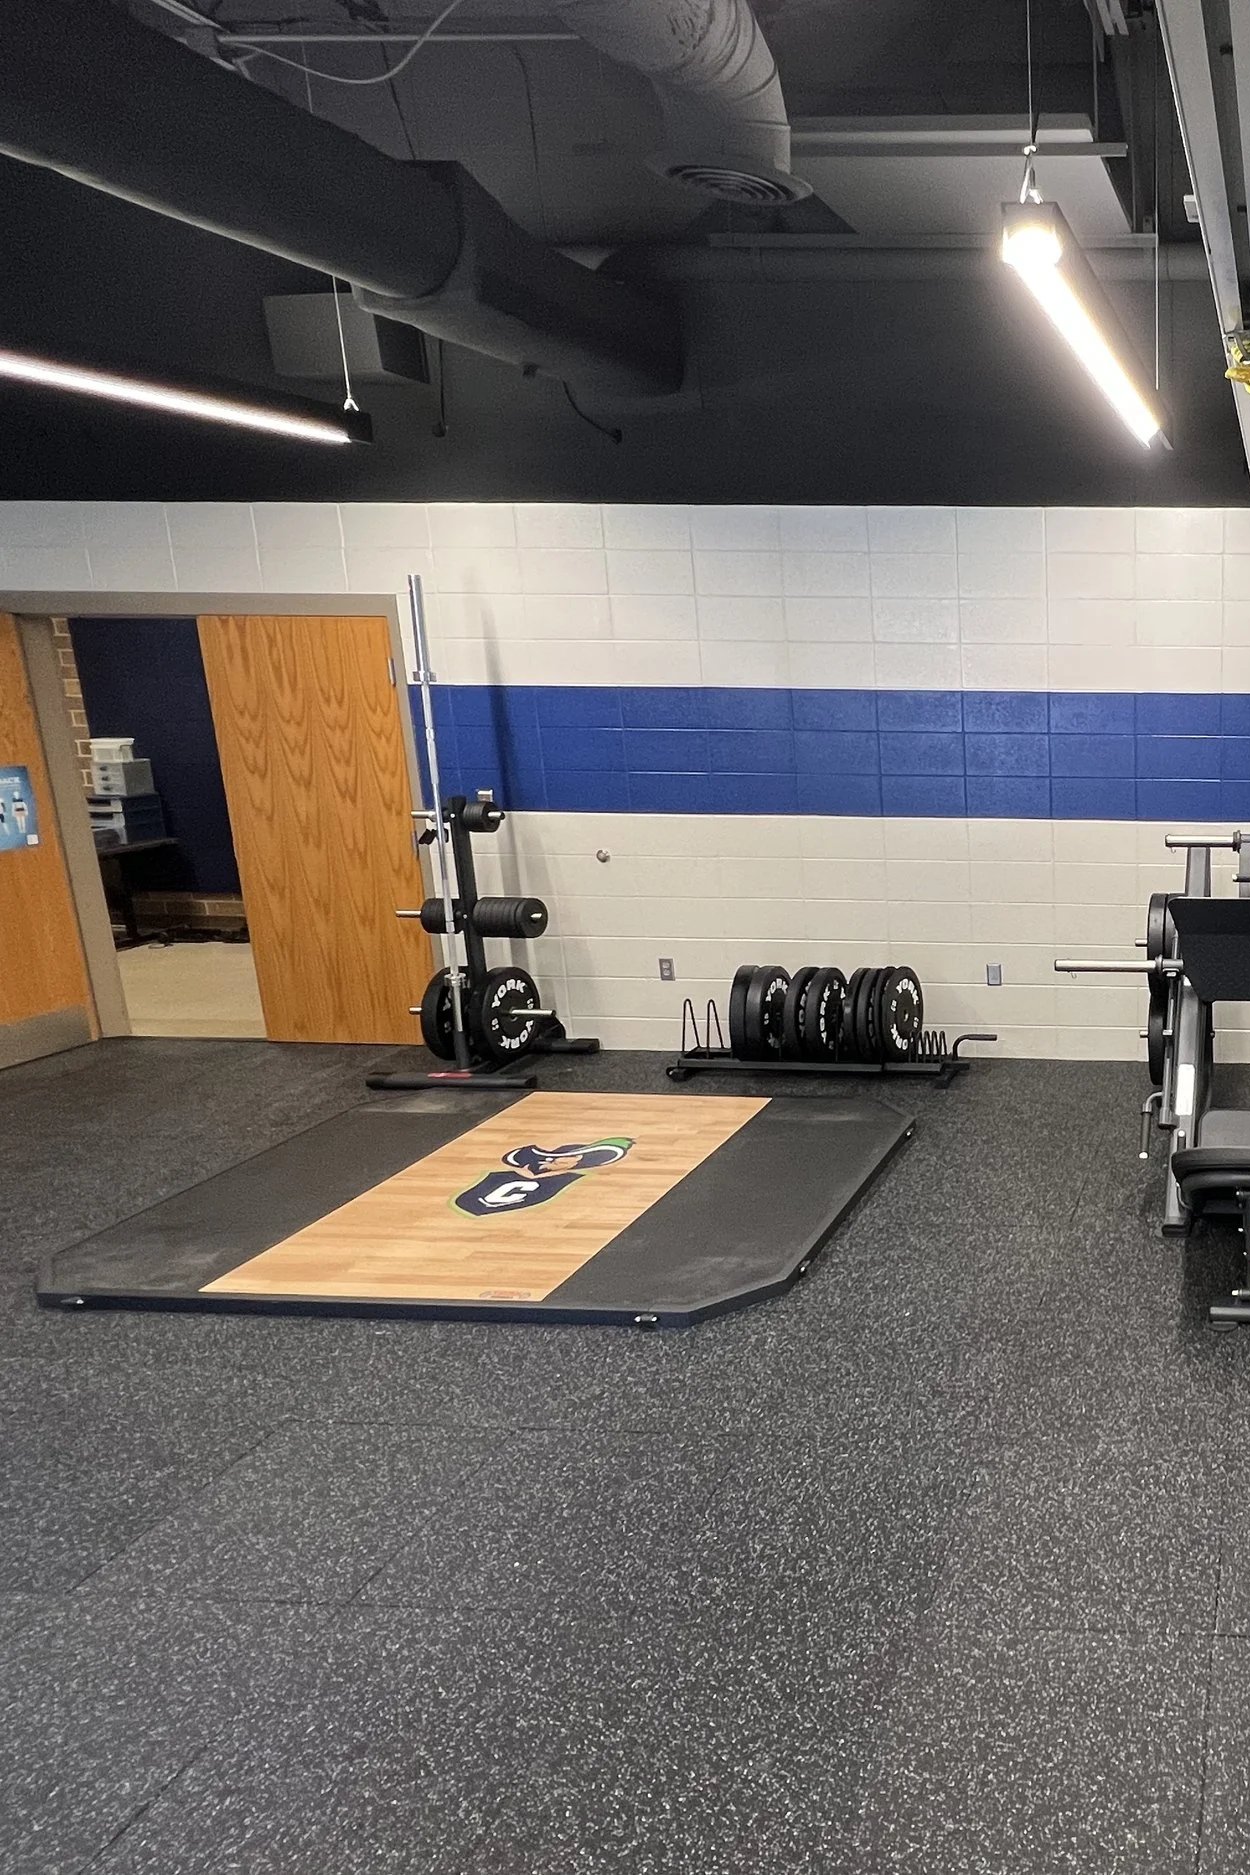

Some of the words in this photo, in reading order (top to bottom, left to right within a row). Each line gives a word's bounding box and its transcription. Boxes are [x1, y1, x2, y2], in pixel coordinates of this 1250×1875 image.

[491, 979, 527, 1008] YORK
[765, 978, 788, 1001] YORK
[896, 978, 919, 1005] YORK
[499, 1020, 534, 1049] YORK
[891, 1023, 911, 1051] ORK
[481, 1181, 540, 1206] C
